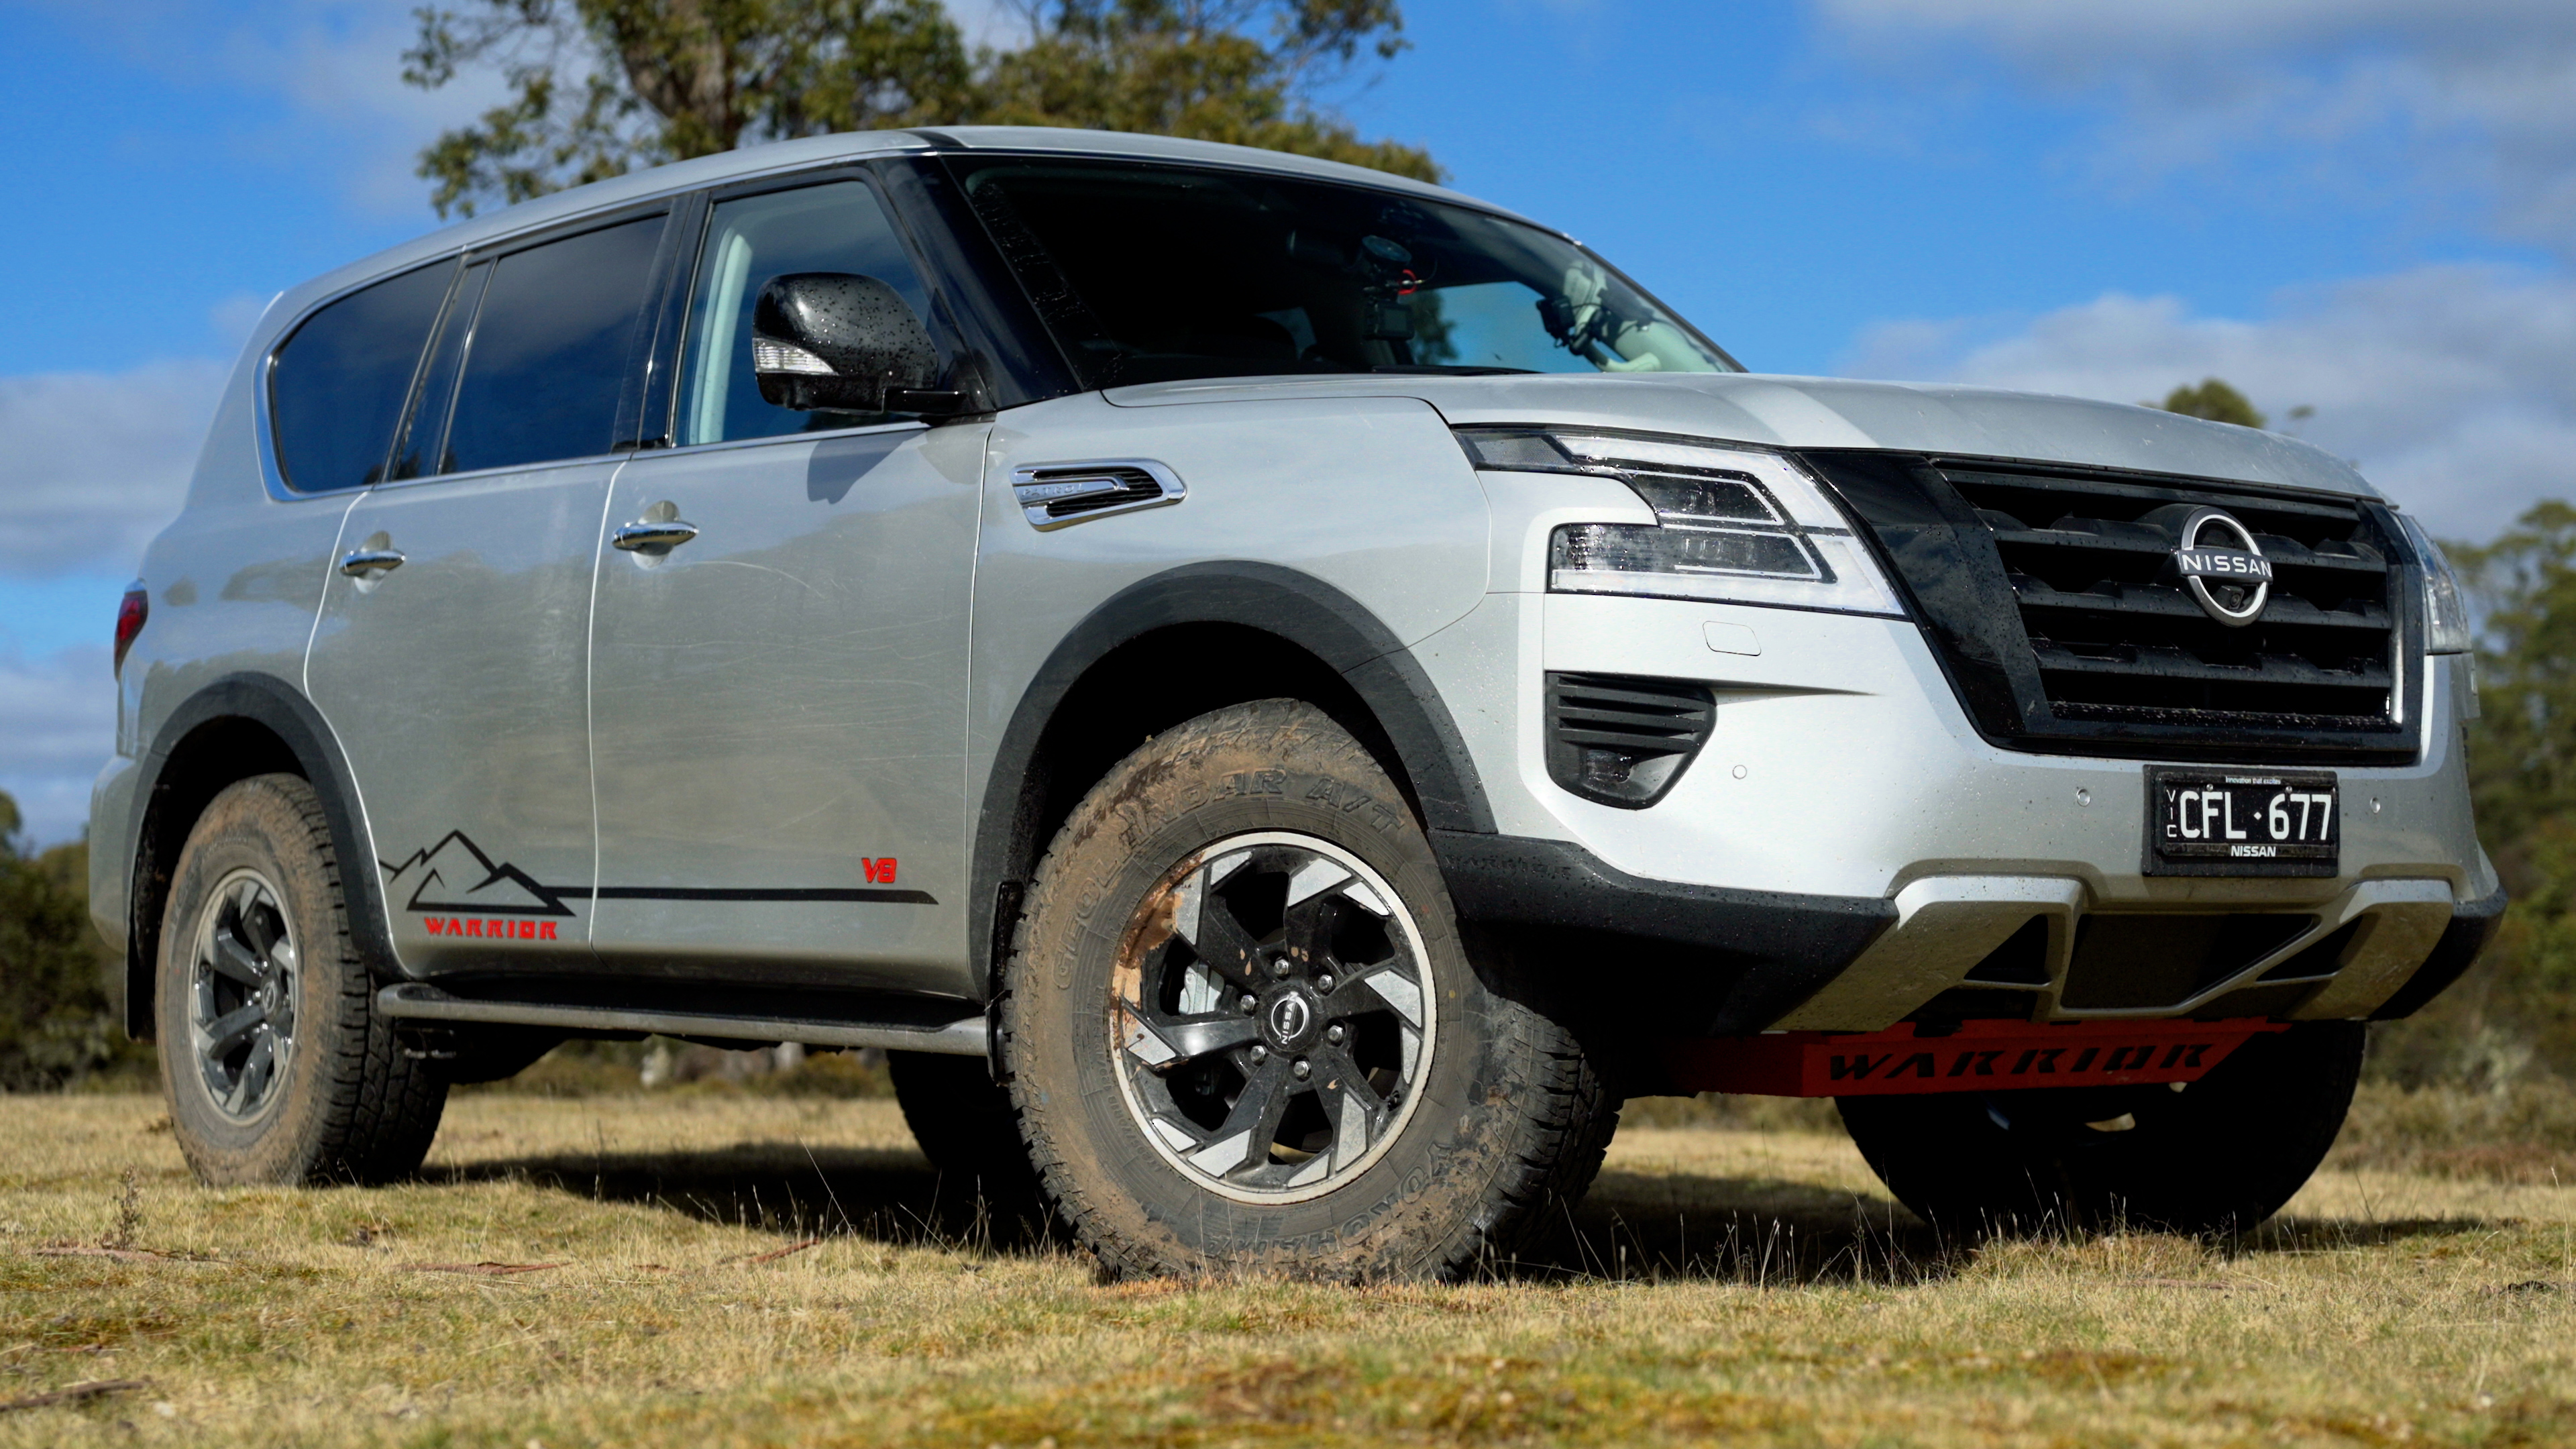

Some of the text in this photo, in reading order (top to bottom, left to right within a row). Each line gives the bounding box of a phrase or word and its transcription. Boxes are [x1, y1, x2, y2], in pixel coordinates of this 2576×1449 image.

[1021, 482, 1087, 498] PATROL
[2182, 554, 2273, 578] NISSAN
[2166, 788, 2178, 838] VIC
[2180, 790, 2332, 841] CFL 677
[2230, 845, 2277, 858] NISSAN
[861, 857, 897, 883] V8
[1052, 767, 1288, 990] GEOLANDAR
[1305, 776, 1405, 834] A/T
[424, 916, 557, 941] WARRIOR
[1281, 990, 1299, 1045] NISSAN
[1829, 1043, 2214, 1081] WARRIOR
